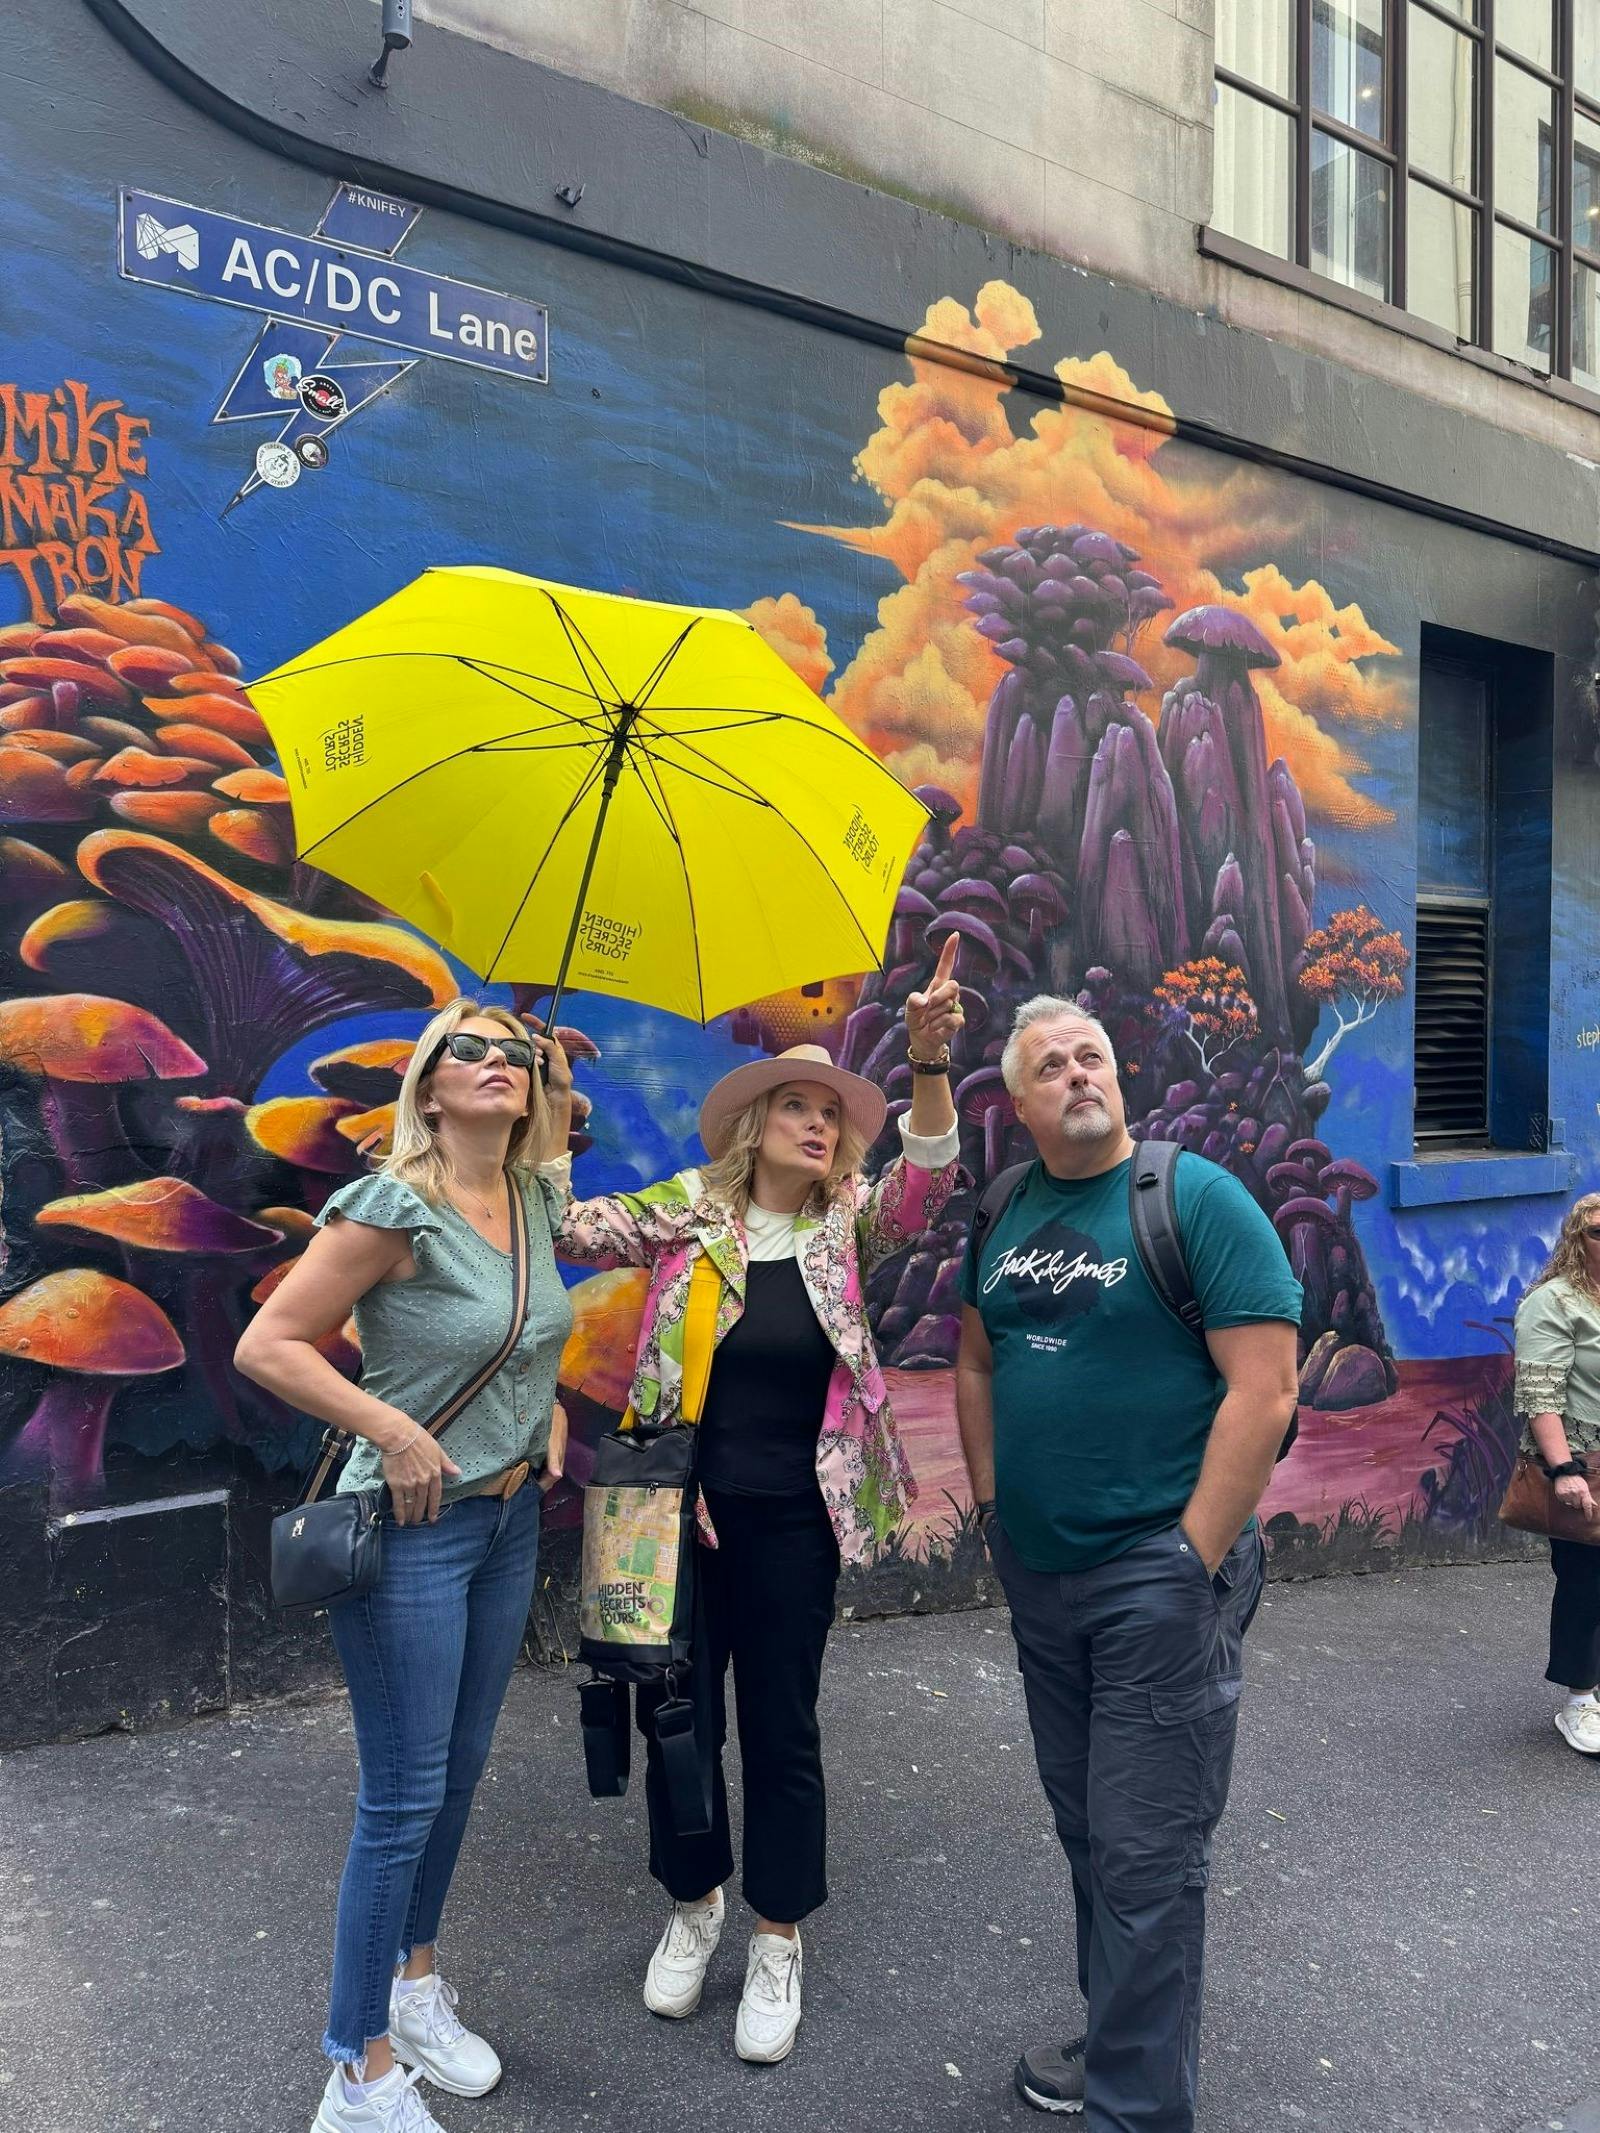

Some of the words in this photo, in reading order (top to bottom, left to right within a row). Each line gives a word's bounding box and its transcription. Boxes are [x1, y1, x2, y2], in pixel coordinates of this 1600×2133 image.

[347, 191, 406, 218] #KNIFEY
[221, 237, 402, 325] AC/DC
[429, 291, 537, 361] Lane
[0, 534, 145, 627] TRON
[1026, 1333, 1068, 1347] WORLDWIDE
[598, 1581, 645, 1600] HIDDEN
[600, 1595, 647, 1613] SECRETS
